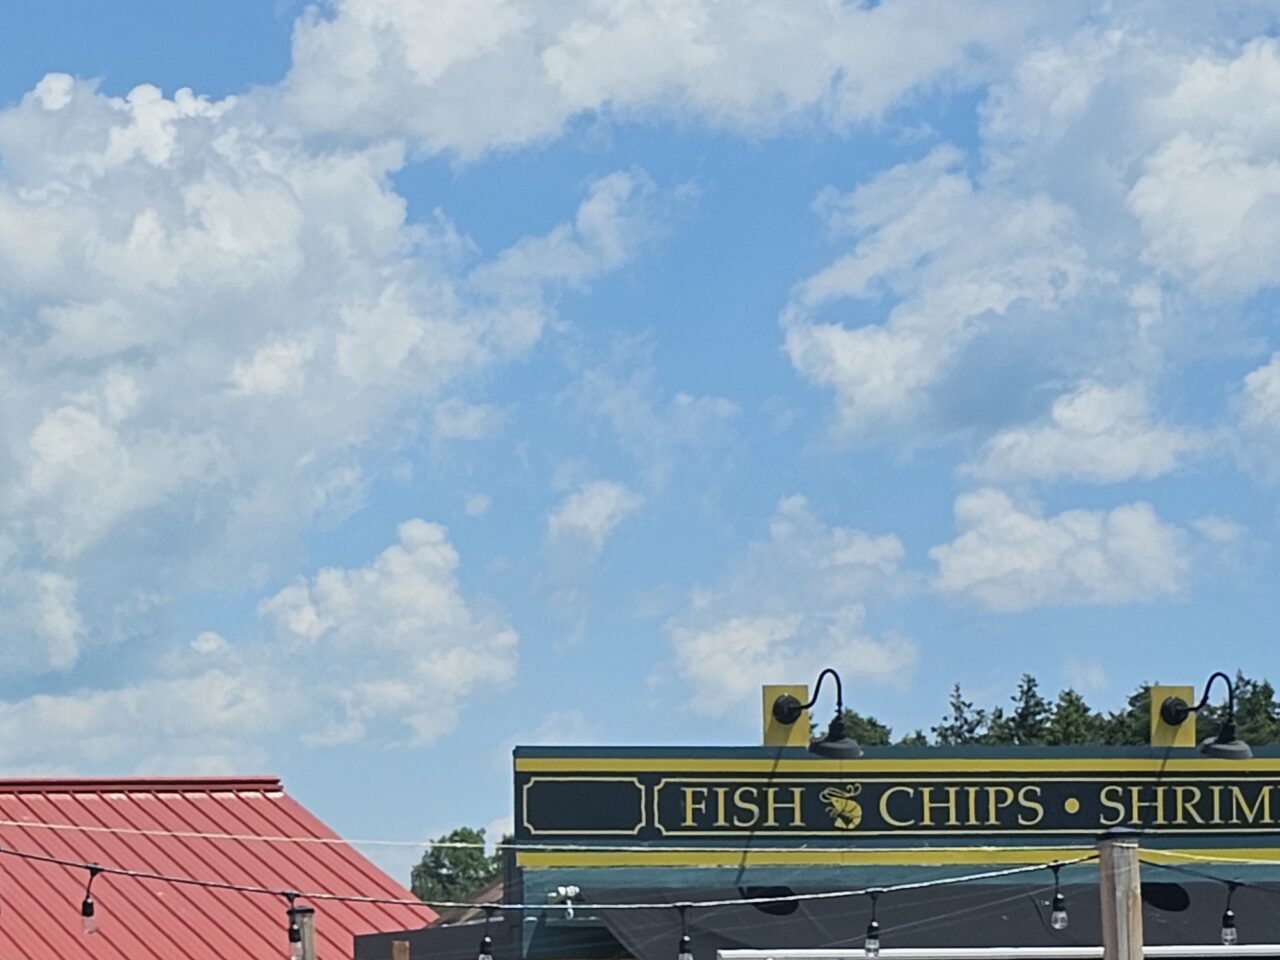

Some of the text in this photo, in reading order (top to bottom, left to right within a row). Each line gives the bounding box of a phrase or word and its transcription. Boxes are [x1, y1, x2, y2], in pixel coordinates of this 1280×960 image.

[681, 785, 1280, 827] FISH CHIPS SHRIM
